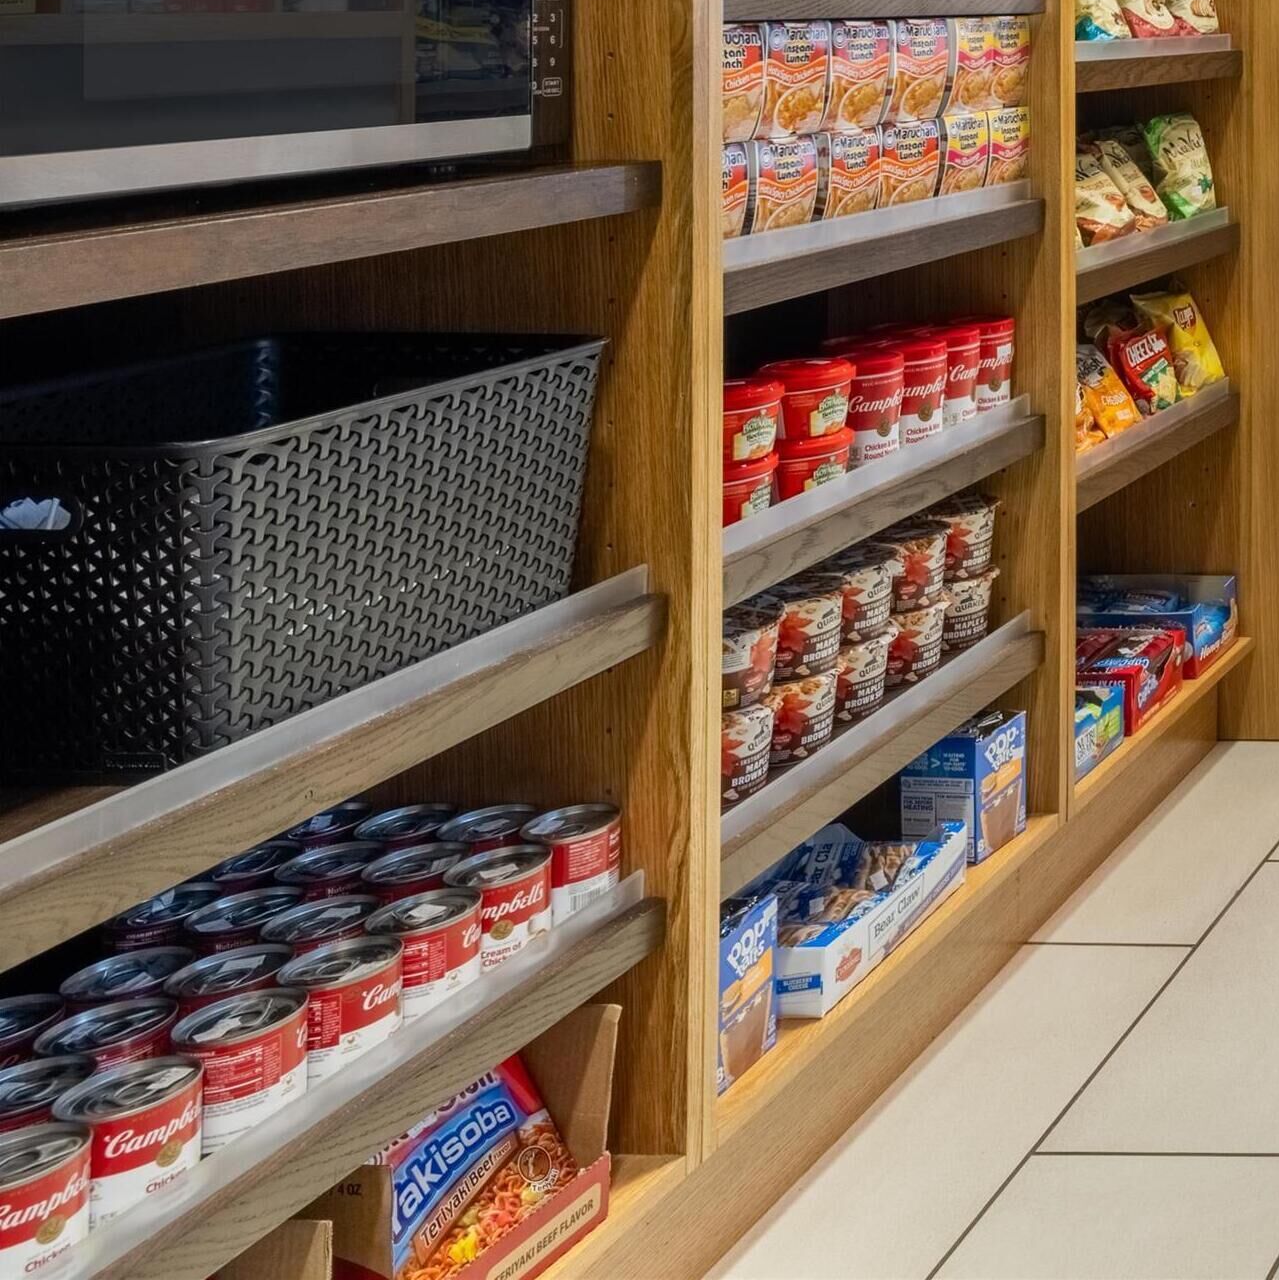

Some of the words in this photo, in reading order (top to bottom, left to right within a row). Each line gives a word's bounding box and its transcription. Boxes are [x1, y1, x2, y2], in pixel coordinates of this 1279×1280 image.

[843, 26, 889, 41] Maruchan
[905, 23, 948, 39] Maruchan
[783, 43, 815, 56] Instant
[909, 37, 937, 50] Instant
[785, 52, 811, 64] Lunch
[850, 49, 875, 62] Lunch
[912, 46, 935, 58] Lunch
[893, 126, 938, 140] Maruchan
[769, 142, 816, 159] Maruchan
[896, 140, 927, 153] Instant
[899, 149, 924, 161] Lunch
[846, 158, 868, 170] Lunch
[776, 168, 803, 181] Lunch
[906, 425, 930, 437] Chicken
[863, 441, 888, 453] Chicken
[943, 625, 973, 640] BROWN
[903, 803, 934, 813] HEATING
[873, 911, 896, 937] Bear
[897, 885, 923, 915] Claw
[480, 944, 511, 961] Cream
[511, 941, 522, 952] of
[782, 976, 813, 987] BLUEBERRY
[787, 982, 809, 992] CHEESE
[530, 1168, 559, 1194] Teriyaki
[419, 1183, 471, 1250] Teriyaki
[469, 1156, 496, 1188] Beef
[535, 1225, 559, 1254] BEEF
[556, 1198, 596, 1238] FLAVOR
